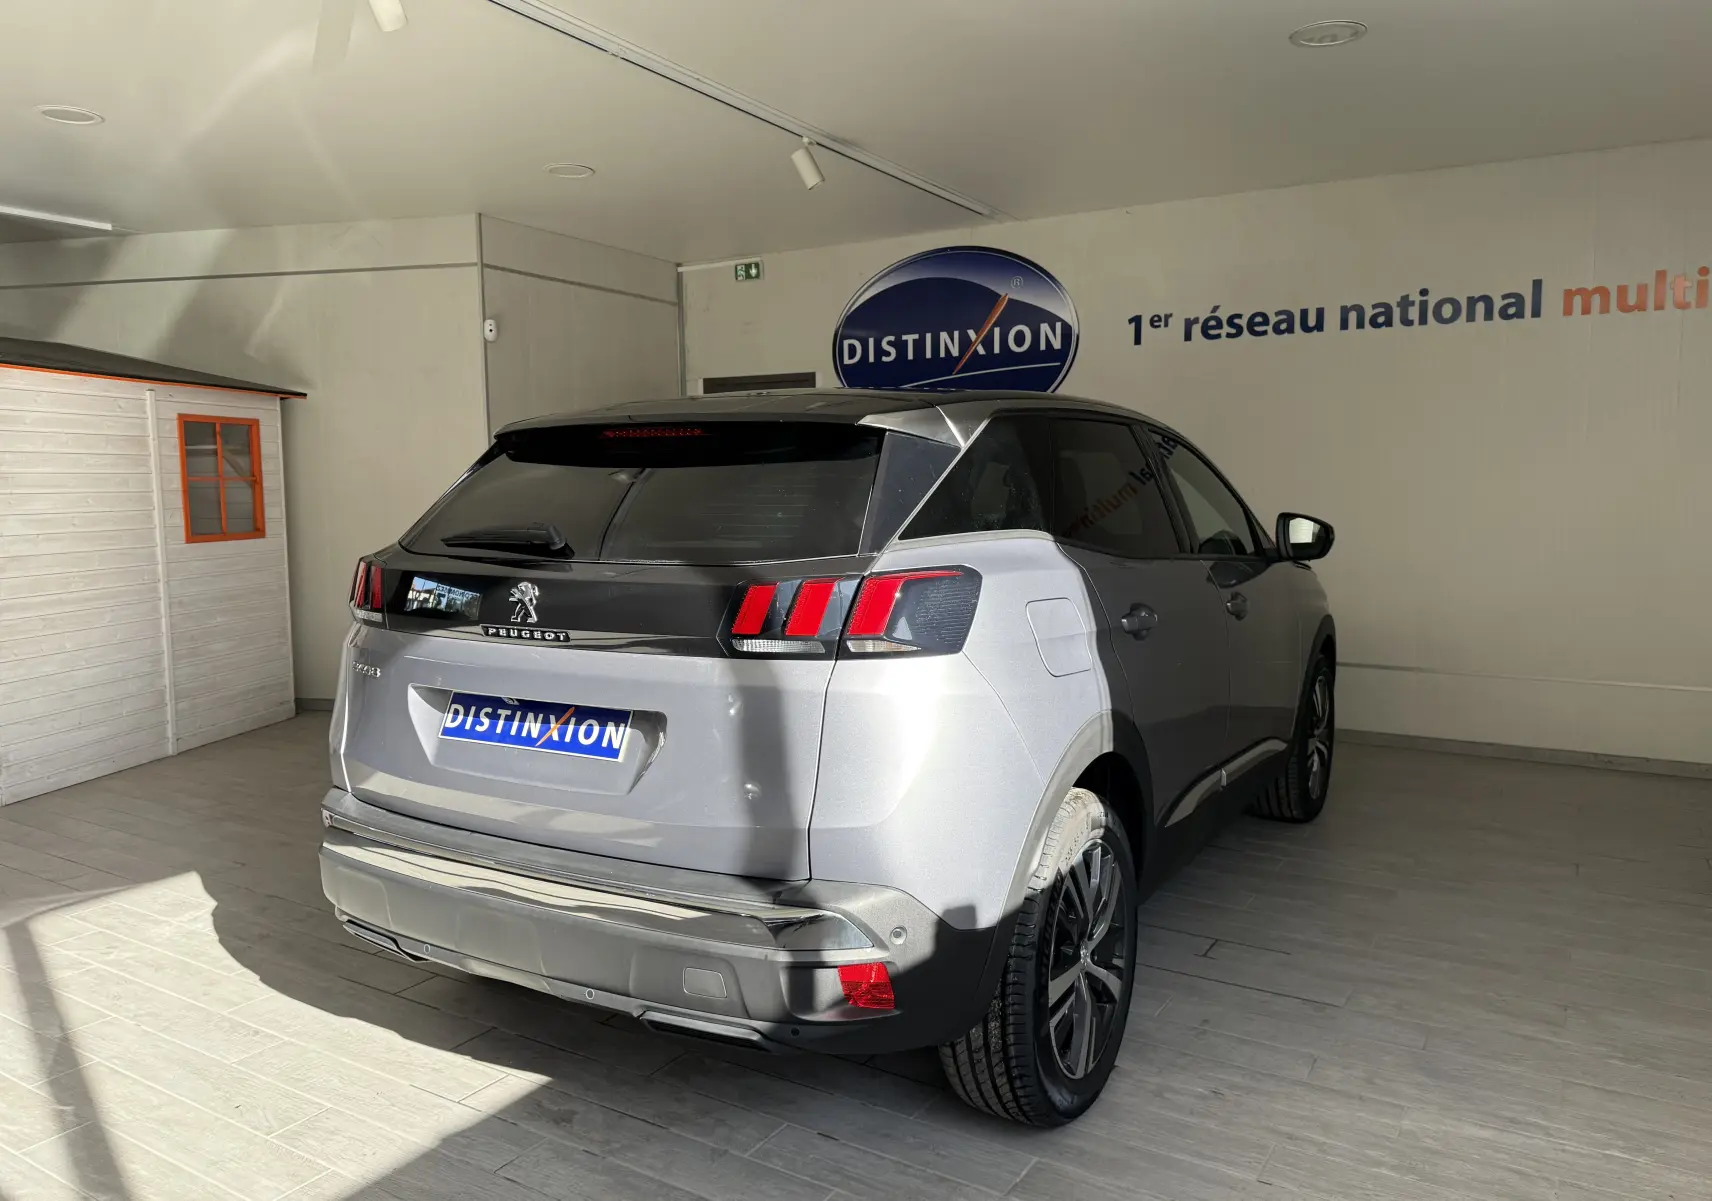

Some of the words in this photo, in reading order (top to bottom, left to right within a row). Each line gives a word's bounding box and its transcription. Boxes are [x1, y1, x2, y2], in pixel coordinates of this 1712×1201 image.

[1127, 310, 1173, 346] 1er
[1183, 305, 1325, 342] réseau
[1339, 279, 1543, 331] national
[1562, 266, 1710, 317] multi
[843, 321, 1062, 366] DISTINXION
[488, 627, 566, 641] PEUGEOT
[444, 703, 626, 750] DISTINXION
